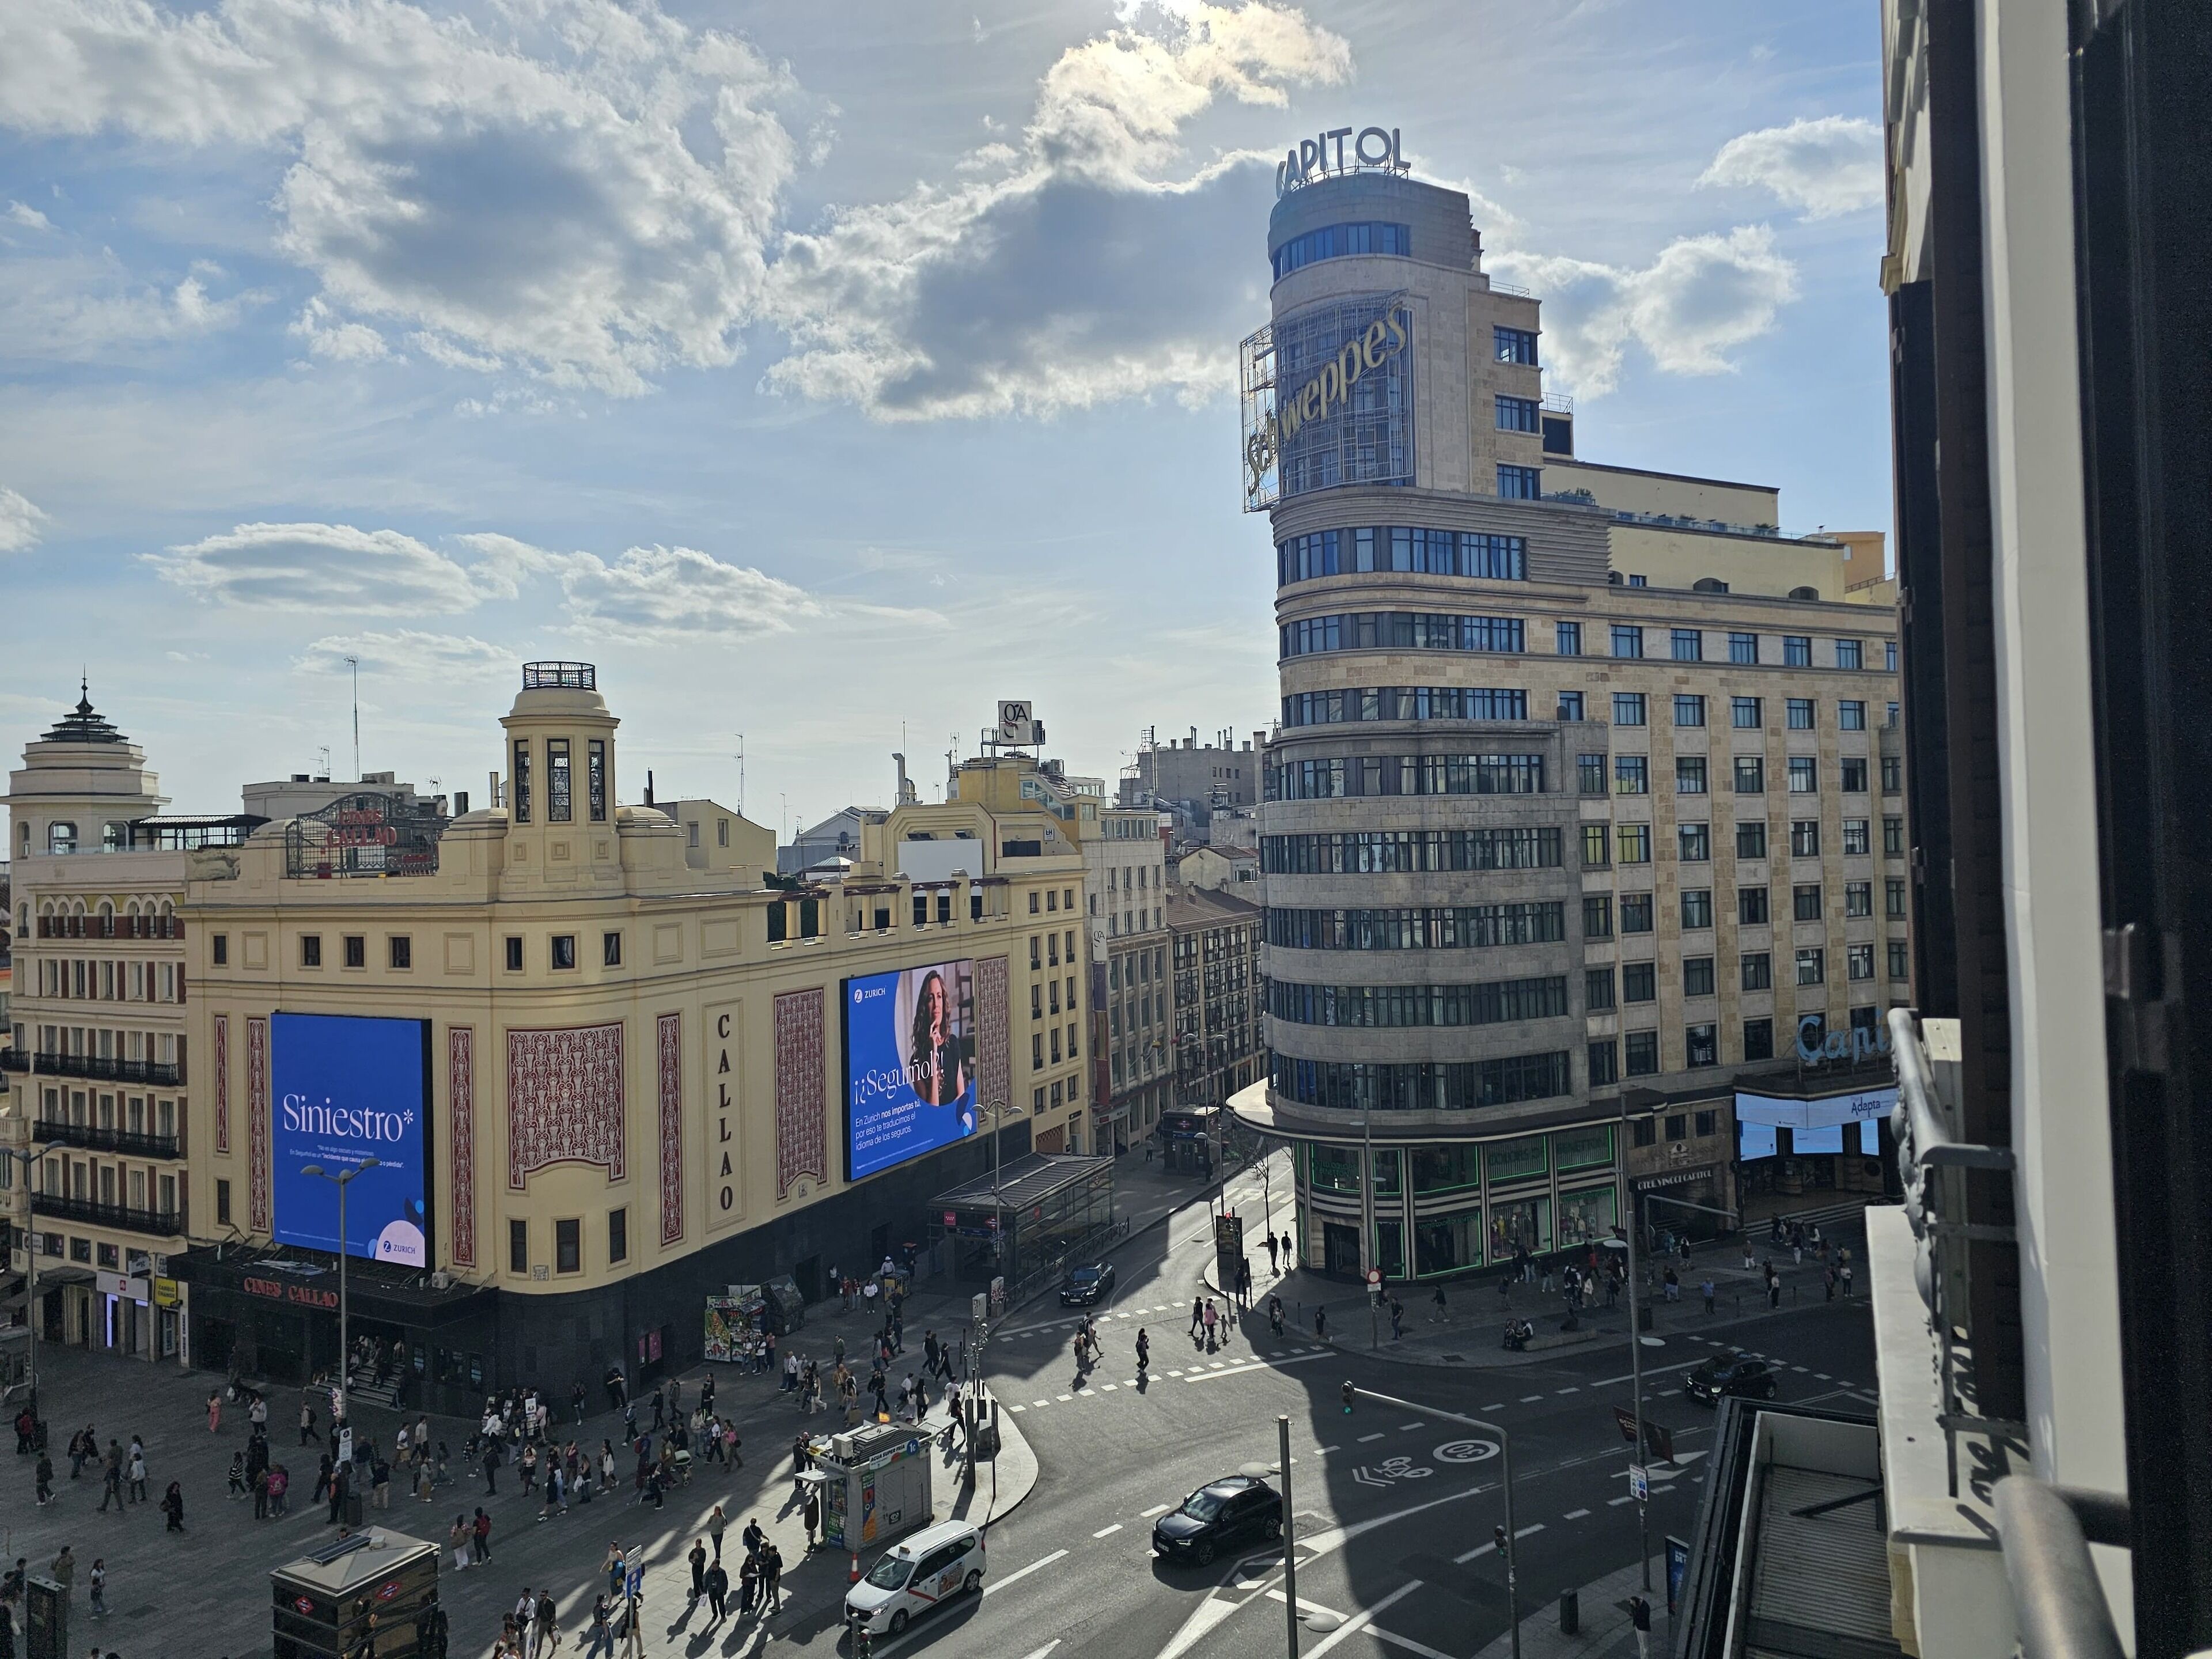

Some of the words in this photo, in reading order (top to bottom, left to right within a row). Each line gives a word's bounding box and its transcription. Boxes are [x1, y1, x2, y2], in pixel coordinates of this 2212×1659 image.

[1277, 126, 1411, 199] CAPITOL
[1247, 301, 1408, 497] Schweppes
[340, 809, 382, 824] CINES
[326, 827, 397, 847] CALLAO
[865, 987, 885, 998] ZURICH
[717, 1013, 733, 1211] CALLAO
[855, 1118, 863, 1127] En
[863, 1112, 881, 1125] Zurich
[881, 1110, 891, 1119] nos
[891, 1102, 914, 1115] importas
[1851, 1096, 1881, 1118] Adapta
[855, 1130, 865, 1141] por
[866, 1126, 876, 1136] eso
[876, 1124, 882, 1132] te
[882, 1115, 911, 1130] traducimos
[911, 1111, 916, 1120] el
[855, 1138, 874, 1151] idioma
[874, 1135, 882, 1144] de
[882, 1132, 891, 1142] los
[393, 1244, 415, 1255] ZURICH
[244, 1277, 282, 1298] CINES
[288, 1286, 339, 1308] CALLAO
[882, 1448, 896, 1457] SUPER
[1446, 1444, 1485, 1458] 30
